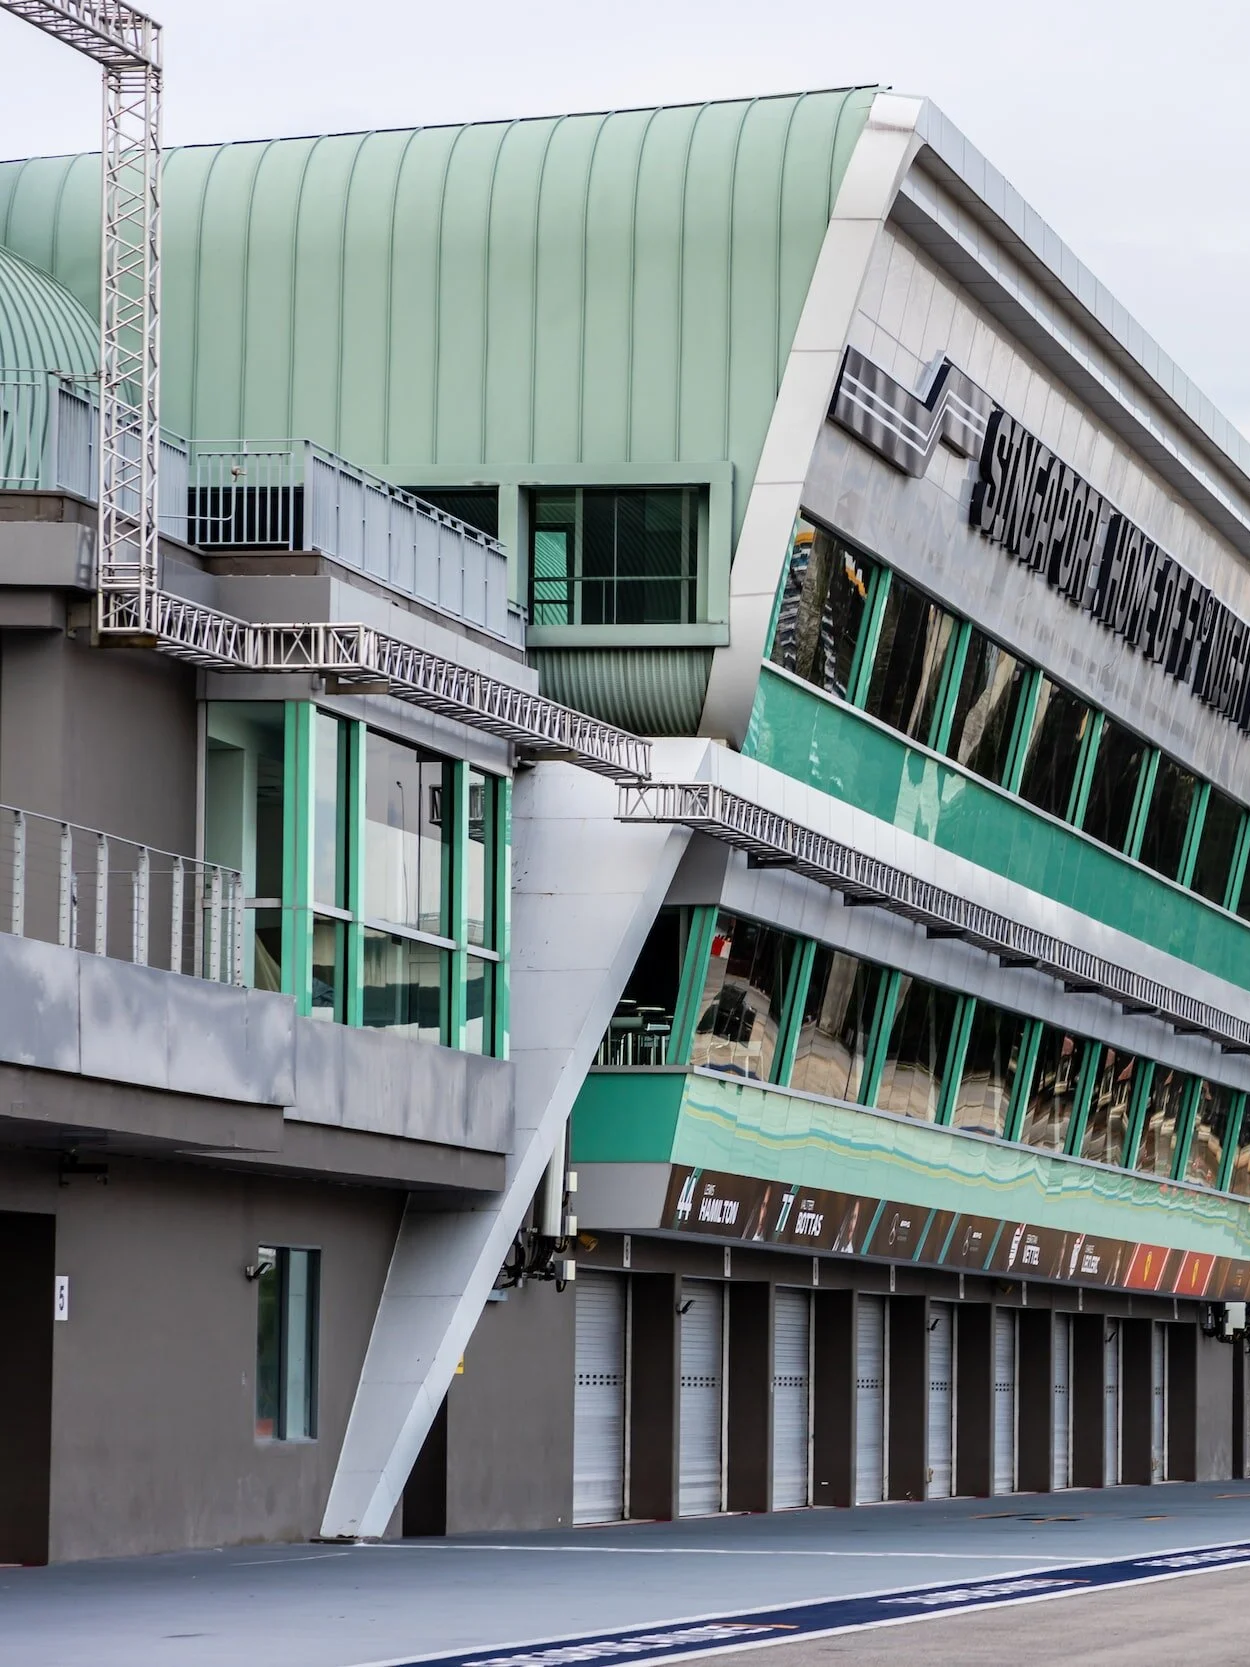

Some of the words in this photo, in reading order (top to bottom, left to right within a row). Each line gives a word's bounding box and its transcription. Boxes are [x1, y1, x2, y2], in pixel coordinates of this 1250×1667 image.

[970, 410, 1111, 611] SINGAPORE
[1099, 514, 1167, 657] HOME
[1152, 560, 1190, 673] OF
[676, 1176, 697, 1220] 44
[698, 1197, 740, 1225] HAMILTON
[775, 1193, 795, 1232] 77
[795, 1211, 824, 1237] BOTTAS
